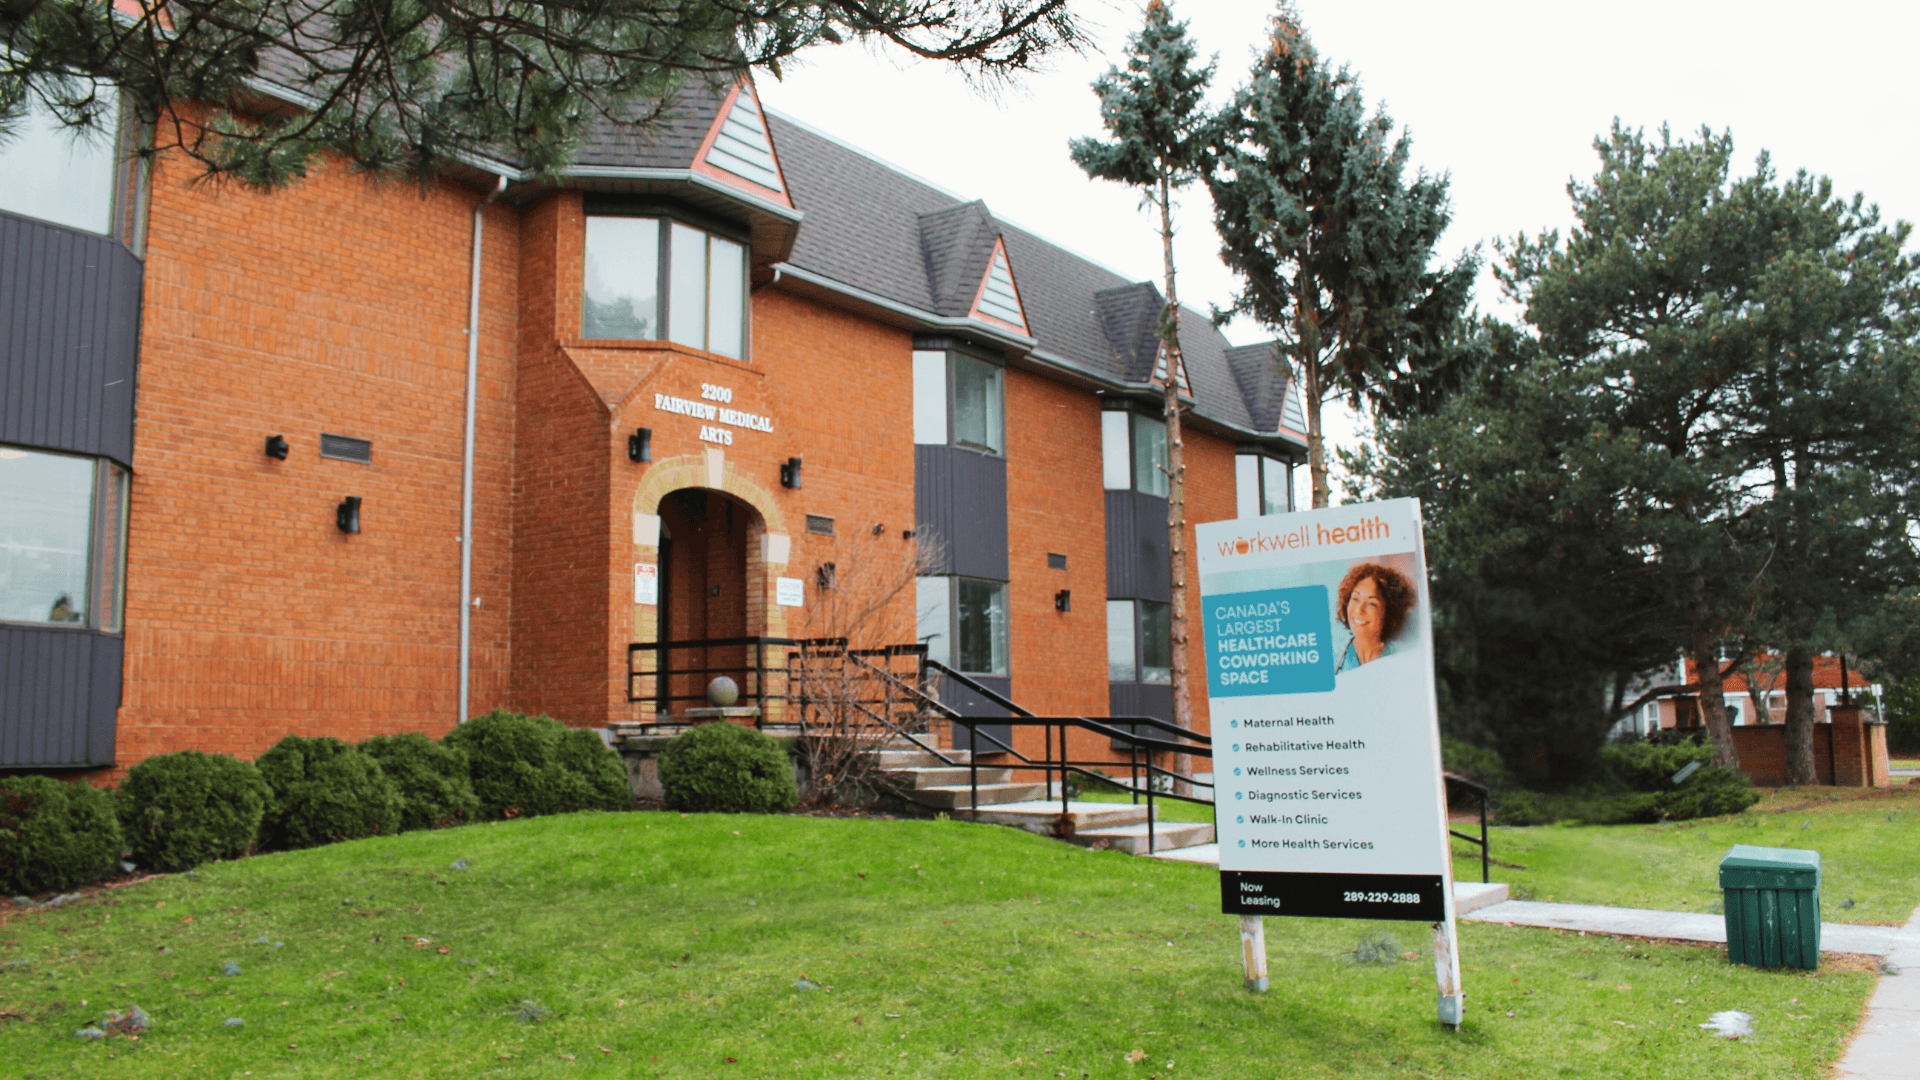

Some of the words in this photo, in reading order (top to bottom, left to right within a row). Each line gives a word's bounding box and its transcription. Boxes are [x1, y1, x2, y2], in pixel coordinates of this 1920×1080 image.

[702, 383, 732, 404] 2200
[655, 394, 717, 420] FAIRVIEW
[719, 408, 774, 432] MEDICAL
[700, 425, 733, 446] ARTS
[1217, 524, 1310, 557] workwell
[1316, 516, 1390, 546] health
[1215, 600, 1291, 620] CANADA'S
[1217, 618, 1282, 636] LARGEST
[1218, 632, 1318, 652] HEALTHCARE
[1219, 650, 1320, 669] COWORKING
[1220, 670, 1270, 686] SPACE
[1244, 718, 1294, 728] Maternal
[1296, 716, 1334, 726] Health
[1246, 741, 1324, 752] Rehabilitative
[1326, 740, 1365, 750] Health
[1247, 766, 1296, 776] Wellness
[1299, 765, 1350, 776] Services
[1248, 790, 1308, 802] Diagnostic
[1312, 790, 1362, 800] Services
[1250, 814, 1293, 824] Walk-In
[1295, 814, 1328, 824] Clinic
[1252, 838, 1280, 848] More
[1282, 838, 1320, 849] Health
[1322, 839, 1374, 850] Services
[1240, 882, 1263, 892] Now
[1240, 895, 1280, 908] Leasing
